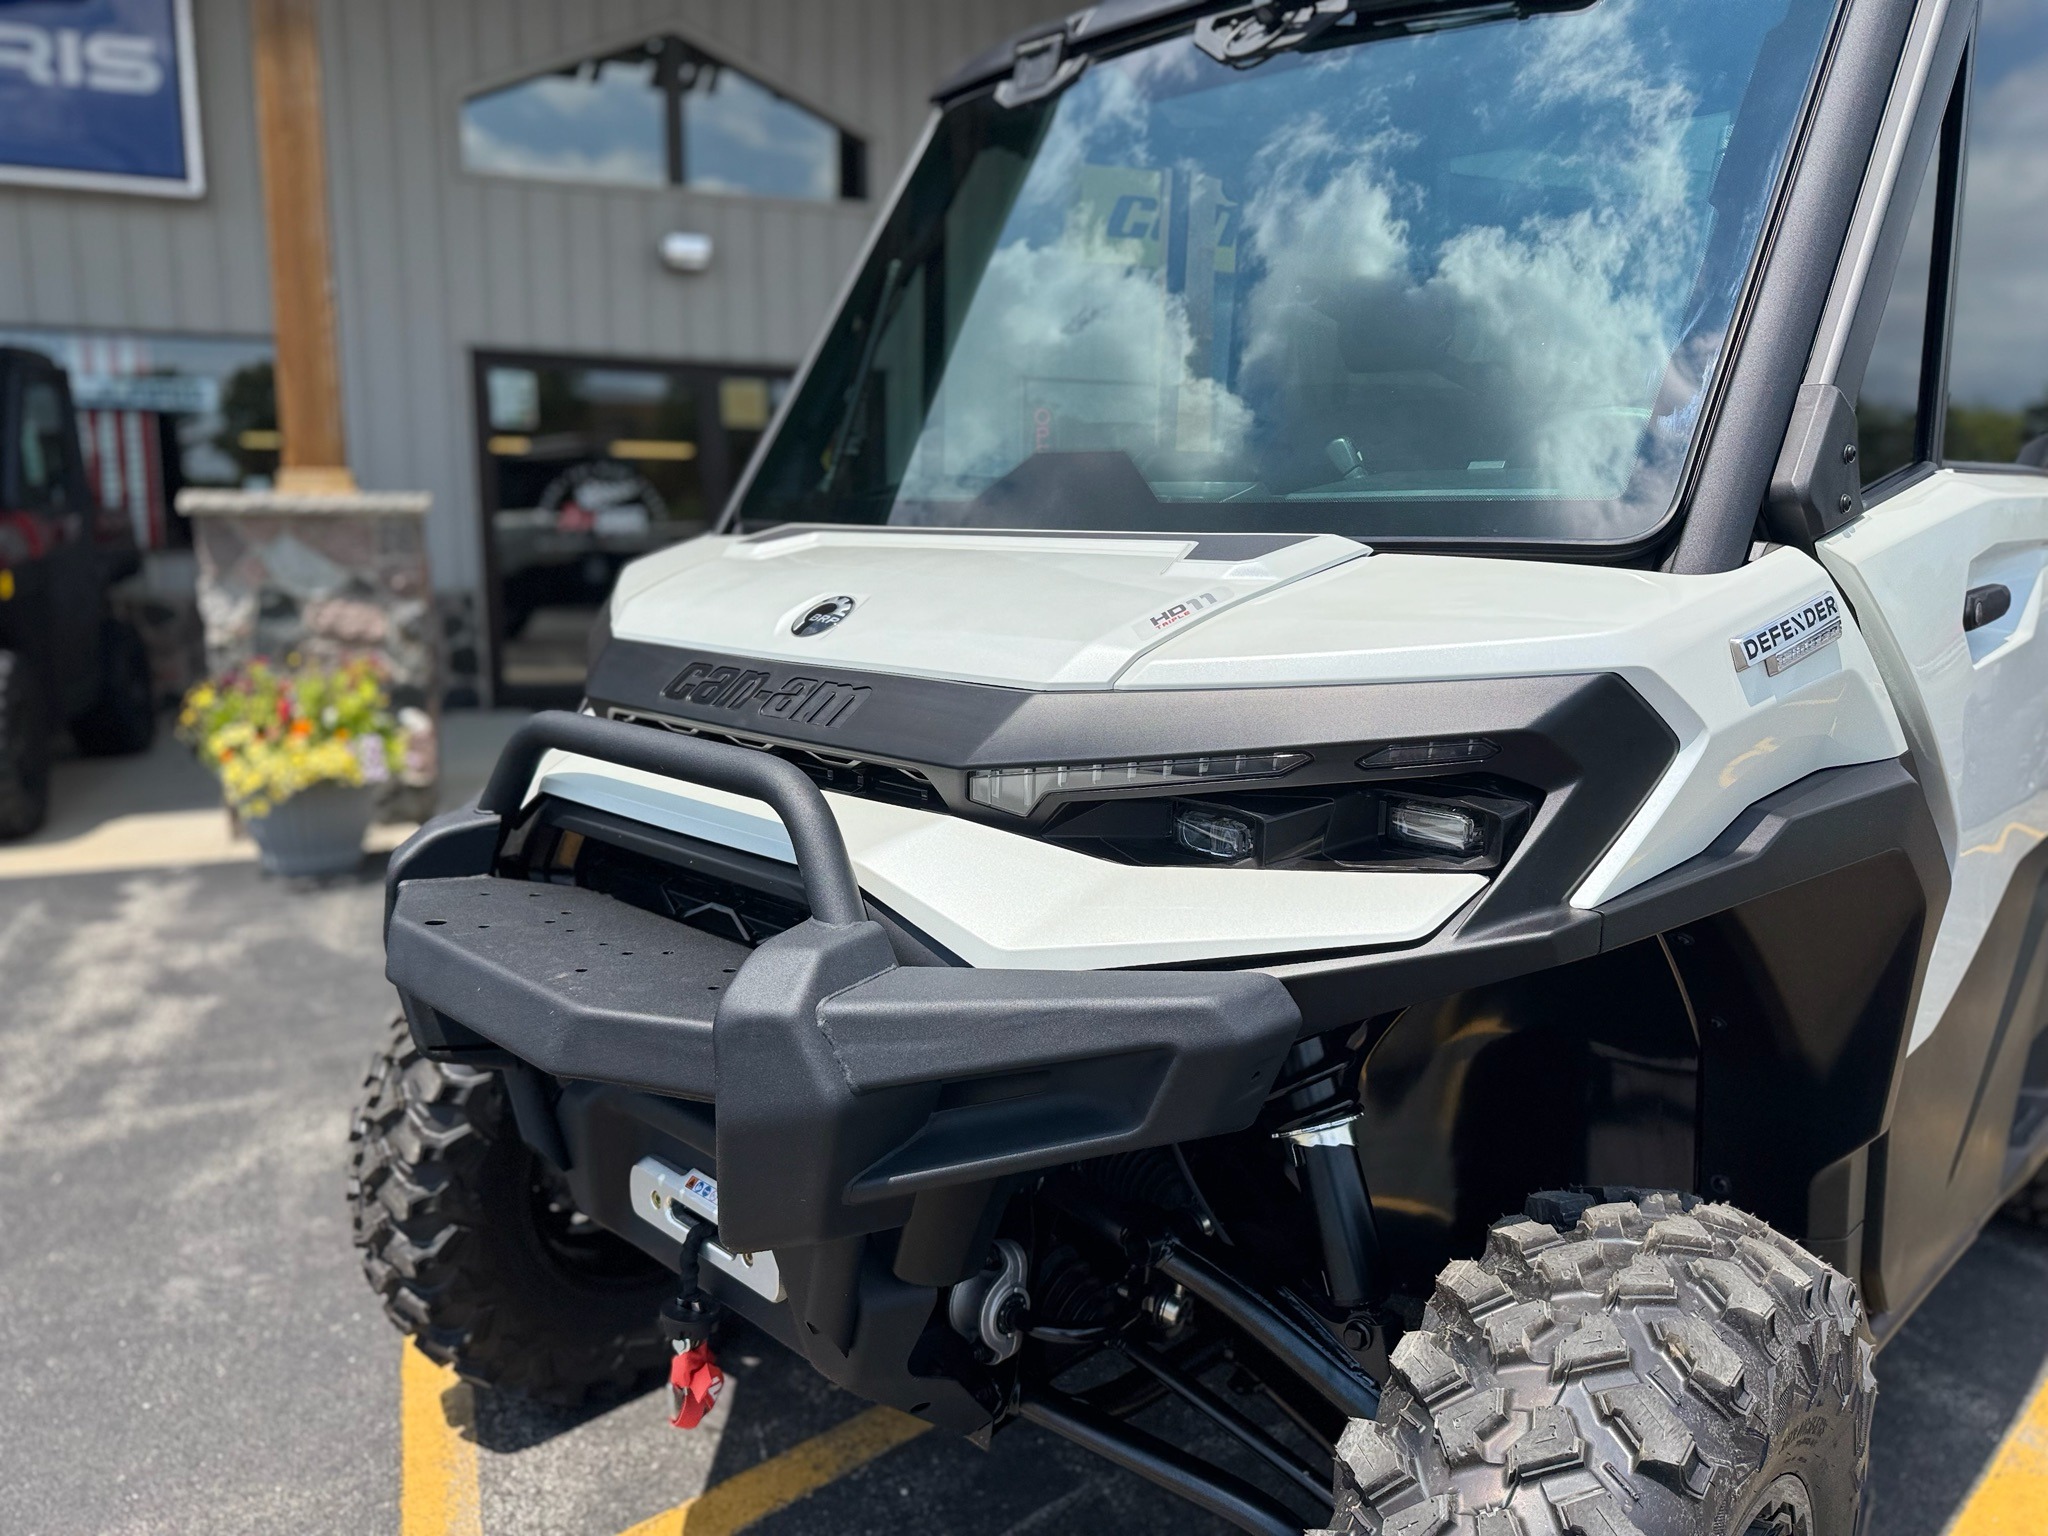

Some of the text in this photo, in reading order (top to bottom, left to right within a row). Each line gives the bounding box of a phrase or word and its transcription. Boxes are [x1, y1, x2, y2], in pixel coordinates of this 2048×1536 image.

[808, 613, 840, 623] BRP
[1156, 610, 1190, 630] TRIPLE
[1743, 595, 1838, 661] DEFENDER
